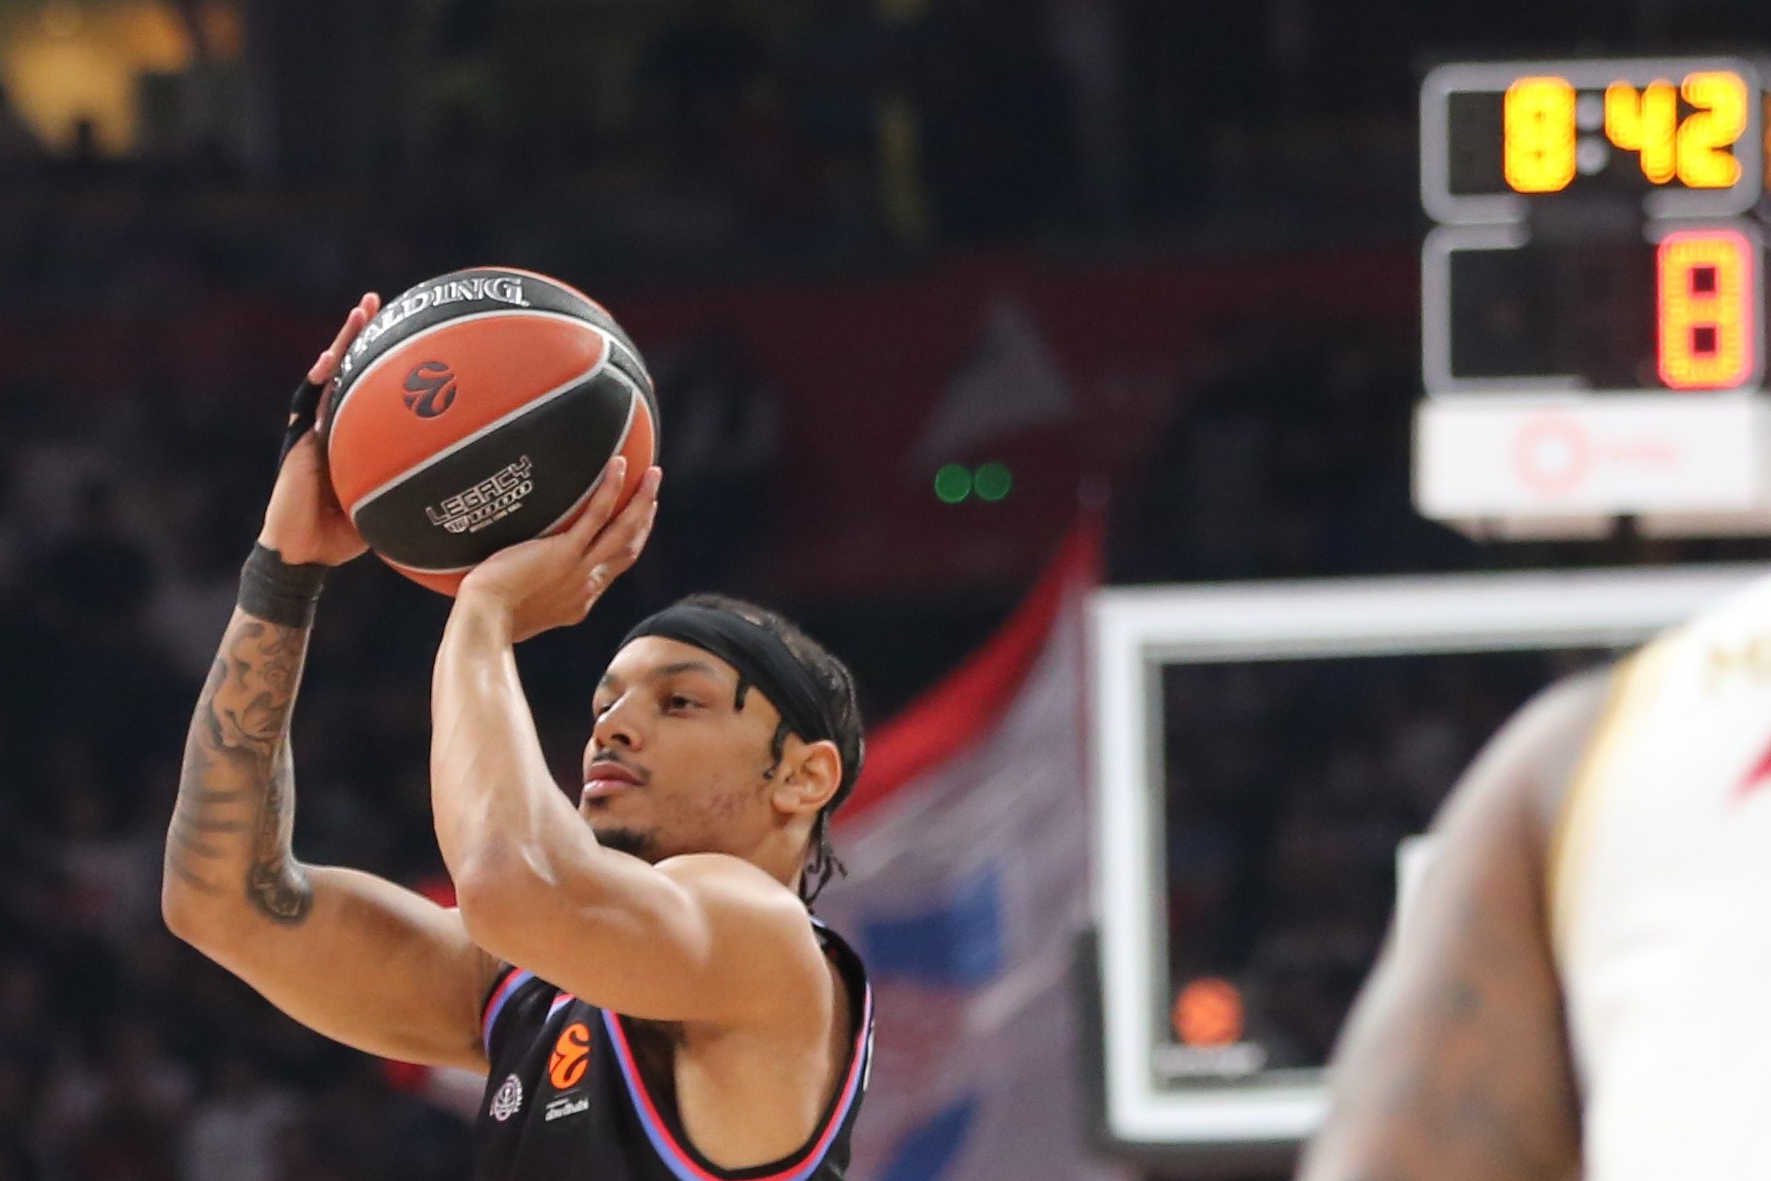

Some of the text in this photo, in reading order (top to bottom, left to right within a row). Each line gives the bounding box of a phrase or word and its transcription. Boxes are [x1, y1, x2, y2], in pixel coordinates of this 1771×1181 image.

[1503, 70, 1749, 193] 8:42
[1655, 230, 1754, 391] 8
[425, 455, 533, 526] LEGACY
